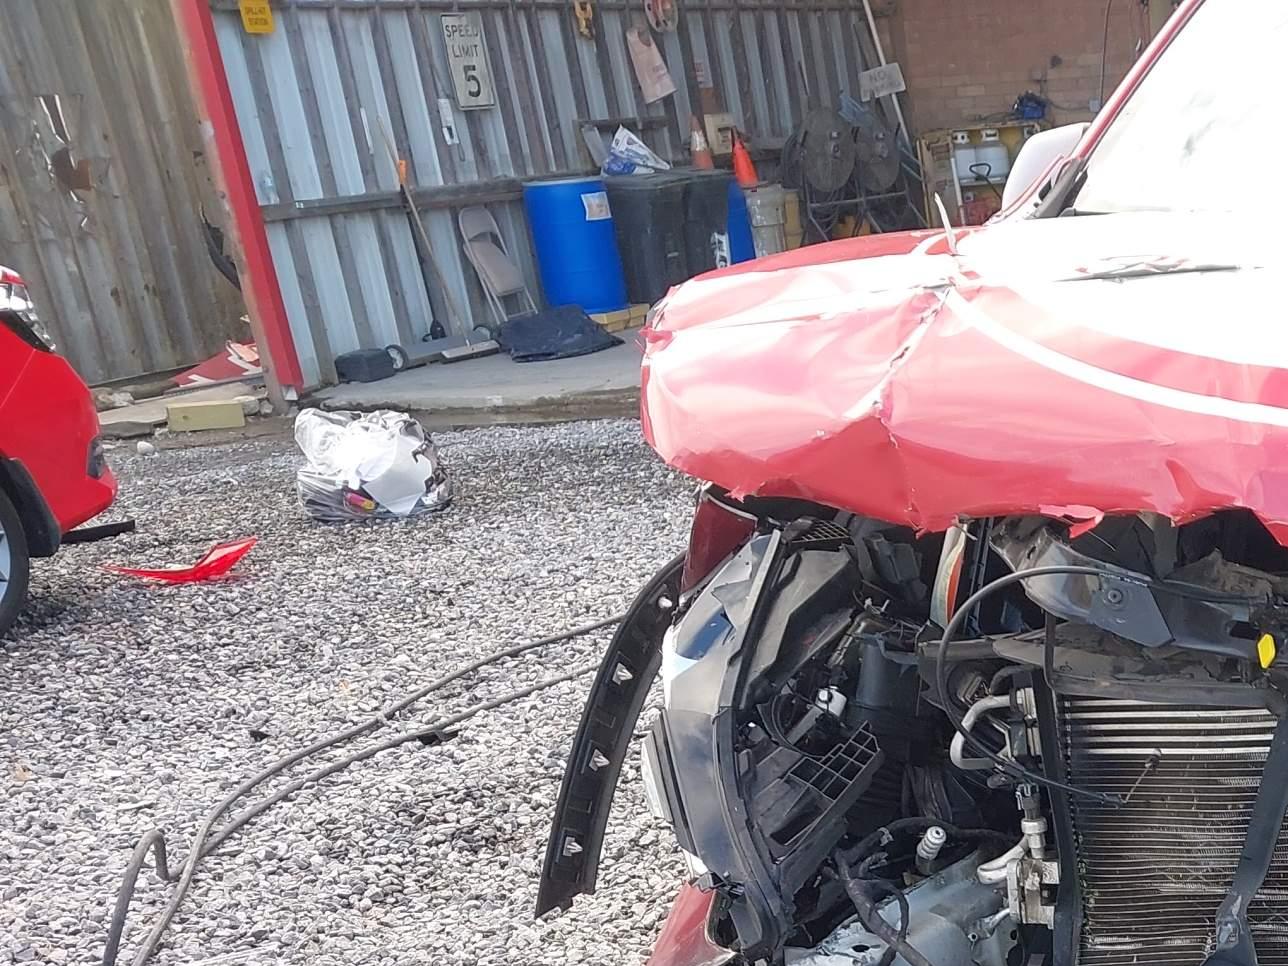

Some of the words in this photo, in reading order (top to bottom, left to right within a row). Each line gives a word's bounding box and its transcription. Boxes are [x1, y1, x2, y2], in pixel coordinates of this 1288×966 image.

[444, 24, 479, 38] SPEED
[452, 44, 480, 58] LIMIT
[463, 64, 482, 98] 5
